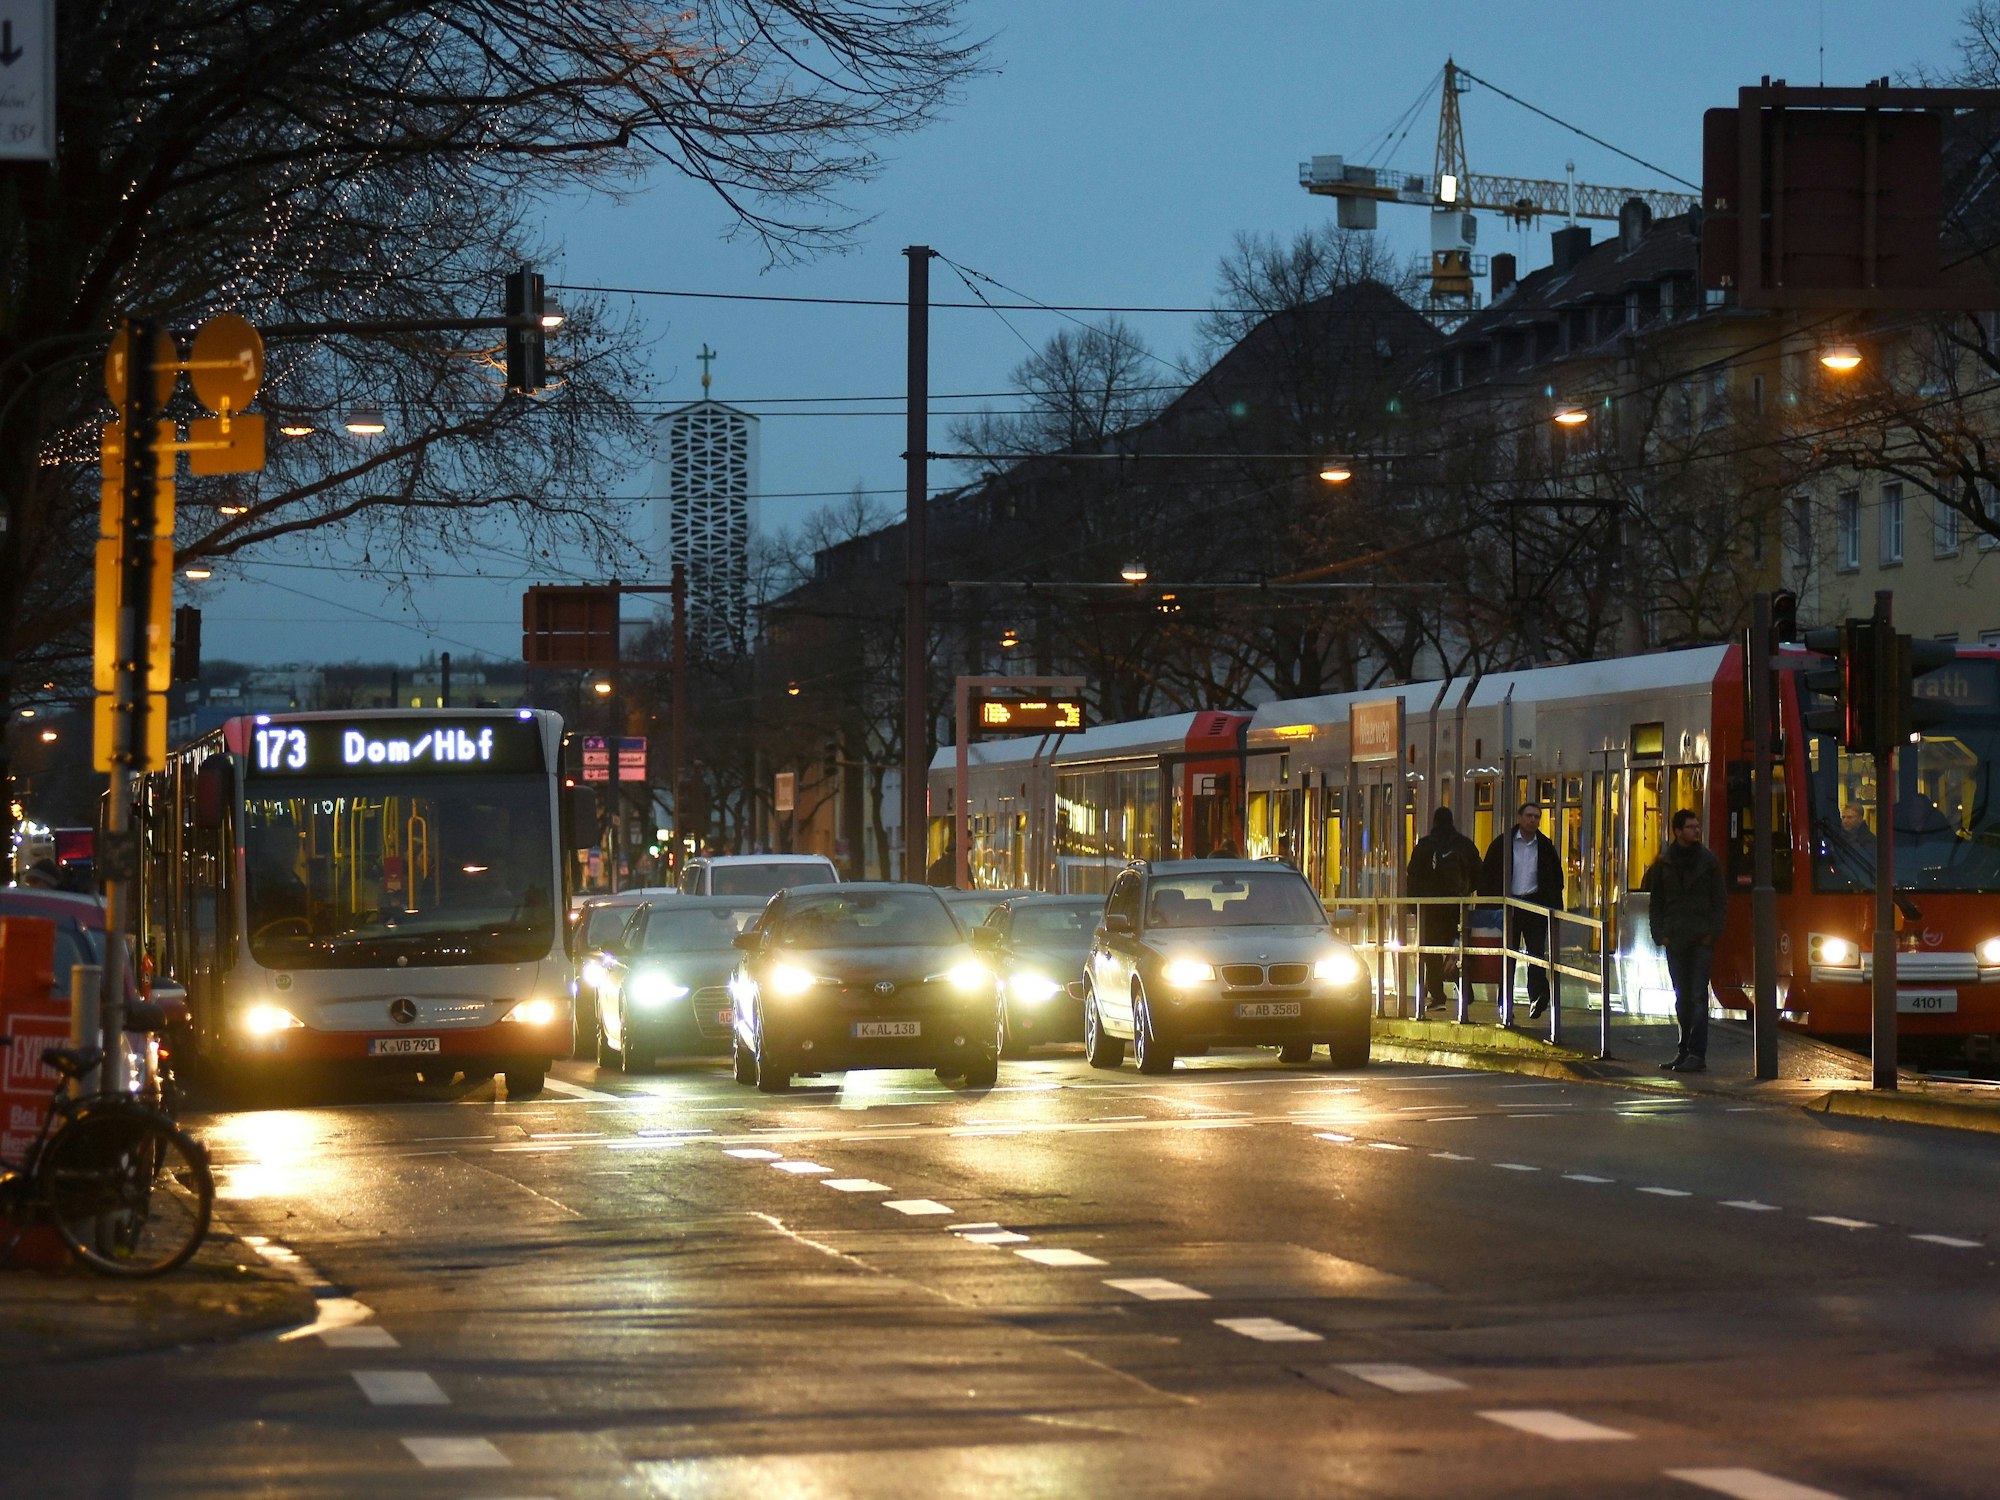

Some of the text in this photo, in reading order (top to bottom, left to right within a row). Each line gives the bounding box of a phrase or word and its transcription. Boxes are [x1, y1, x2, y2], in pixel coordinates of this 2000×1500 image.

[255, 728, 493, 769] 173 Dom/Hbf
[1911, 997, 1943, 1009] 4101
[876, 1023, 892, 1035] AL
[893, 1023, 916, 1035] 138
[395, 1039, 412, 1052] VB
[412, 1038, 436, 1052] 790
